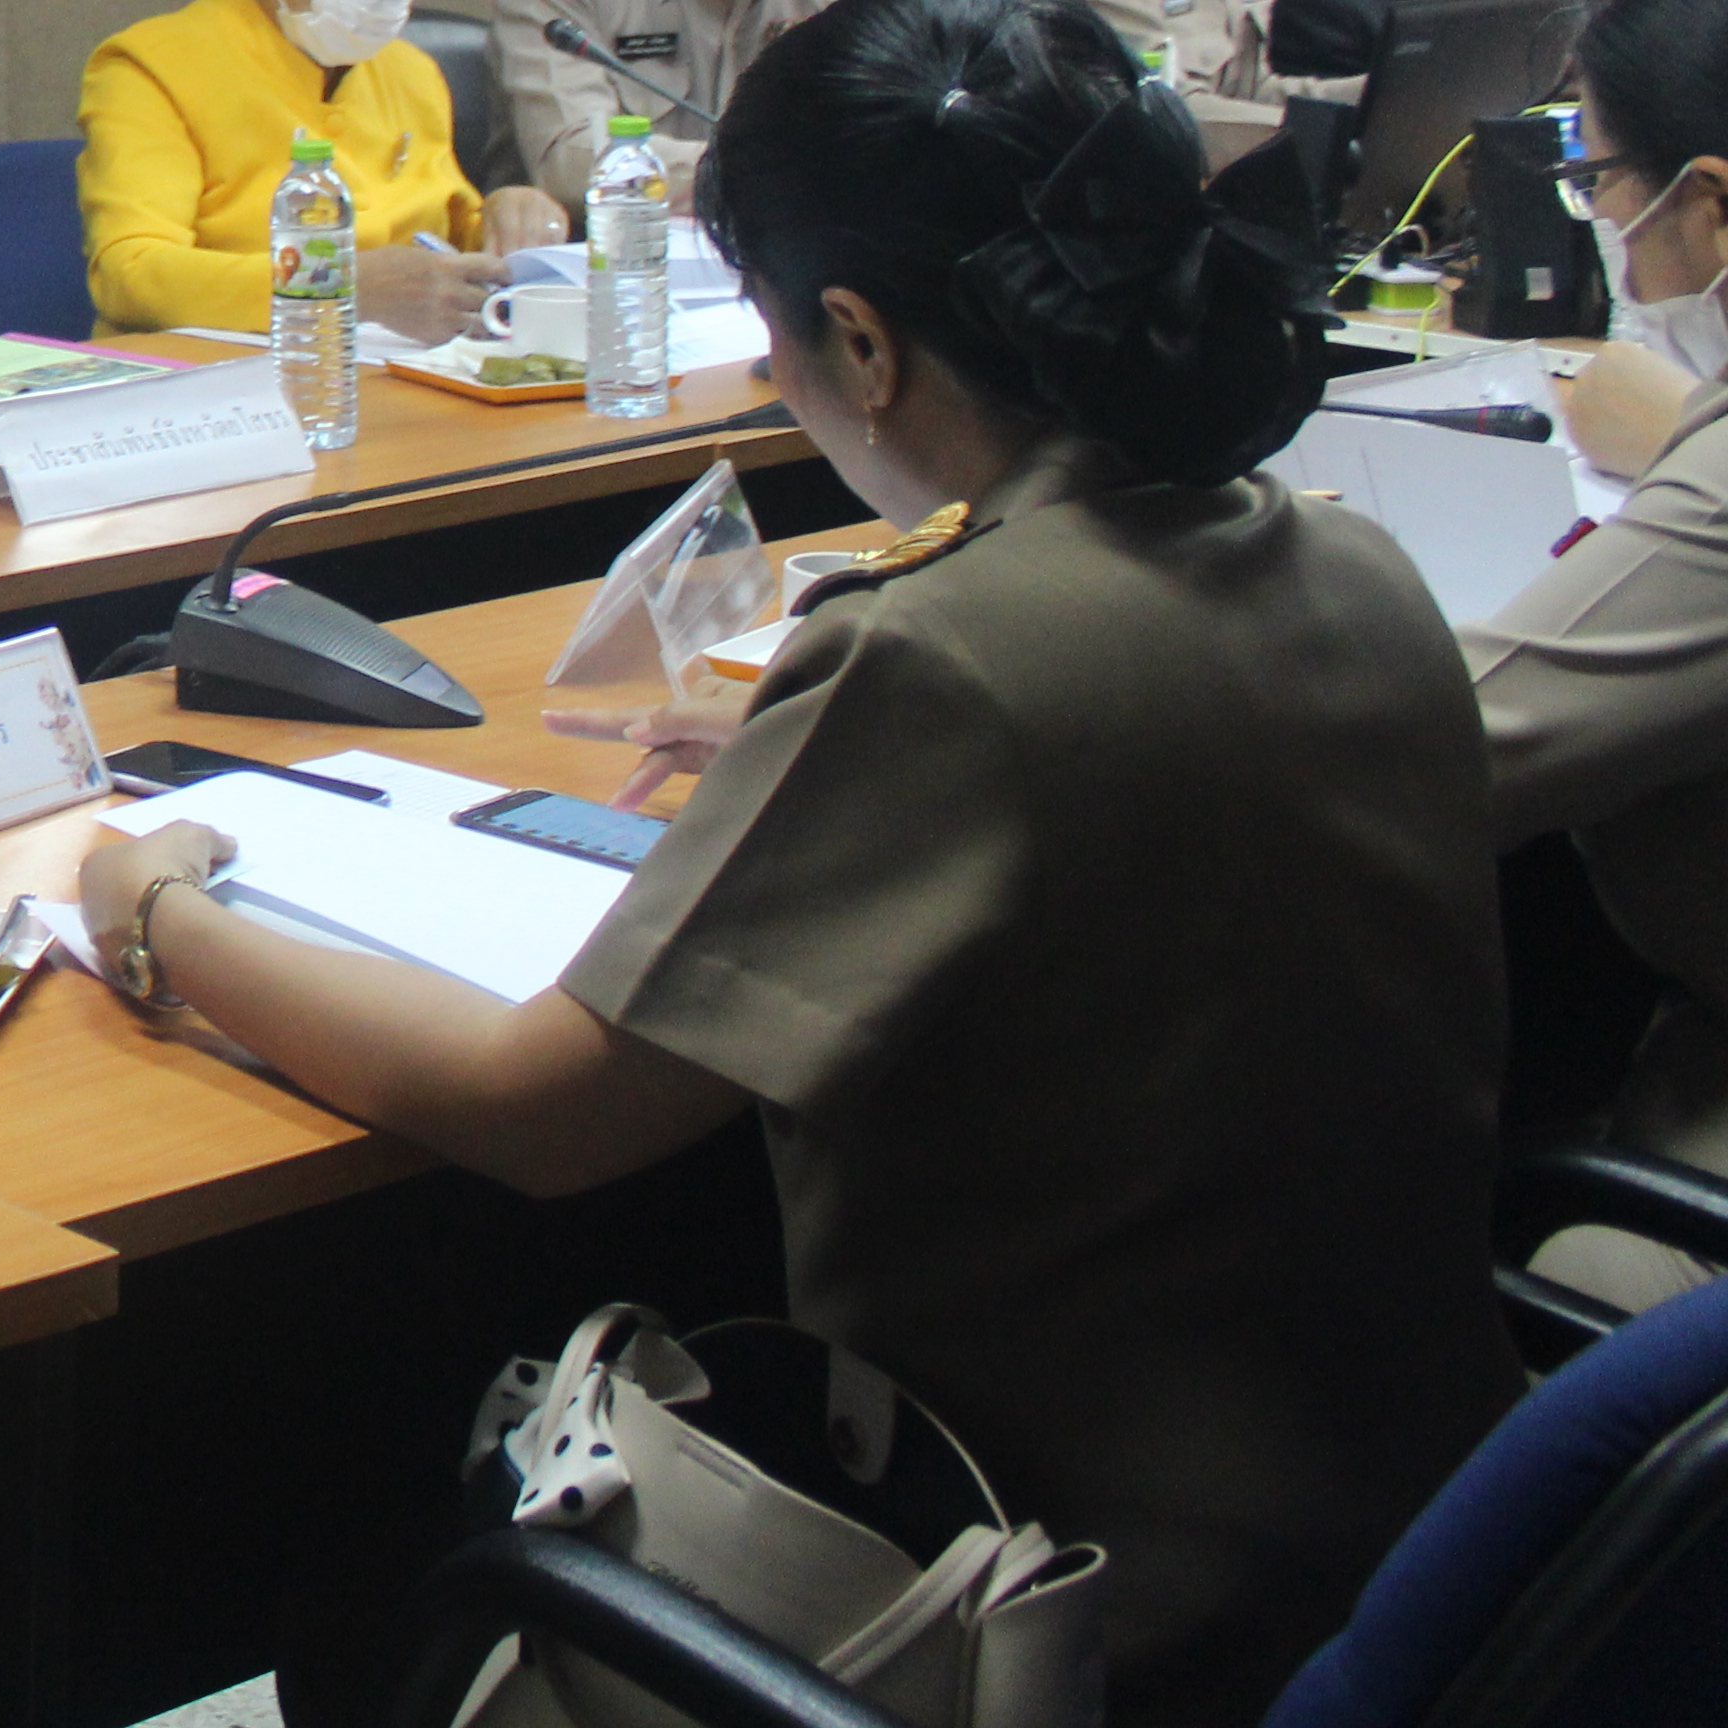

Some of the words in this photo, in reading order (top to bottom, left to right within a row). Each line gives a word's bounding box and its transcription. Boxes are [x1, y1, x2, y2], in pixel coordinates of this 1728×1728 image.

[29, 406, 292, 470] ประชาสัมพันธ์จังหวัดยโสธร
